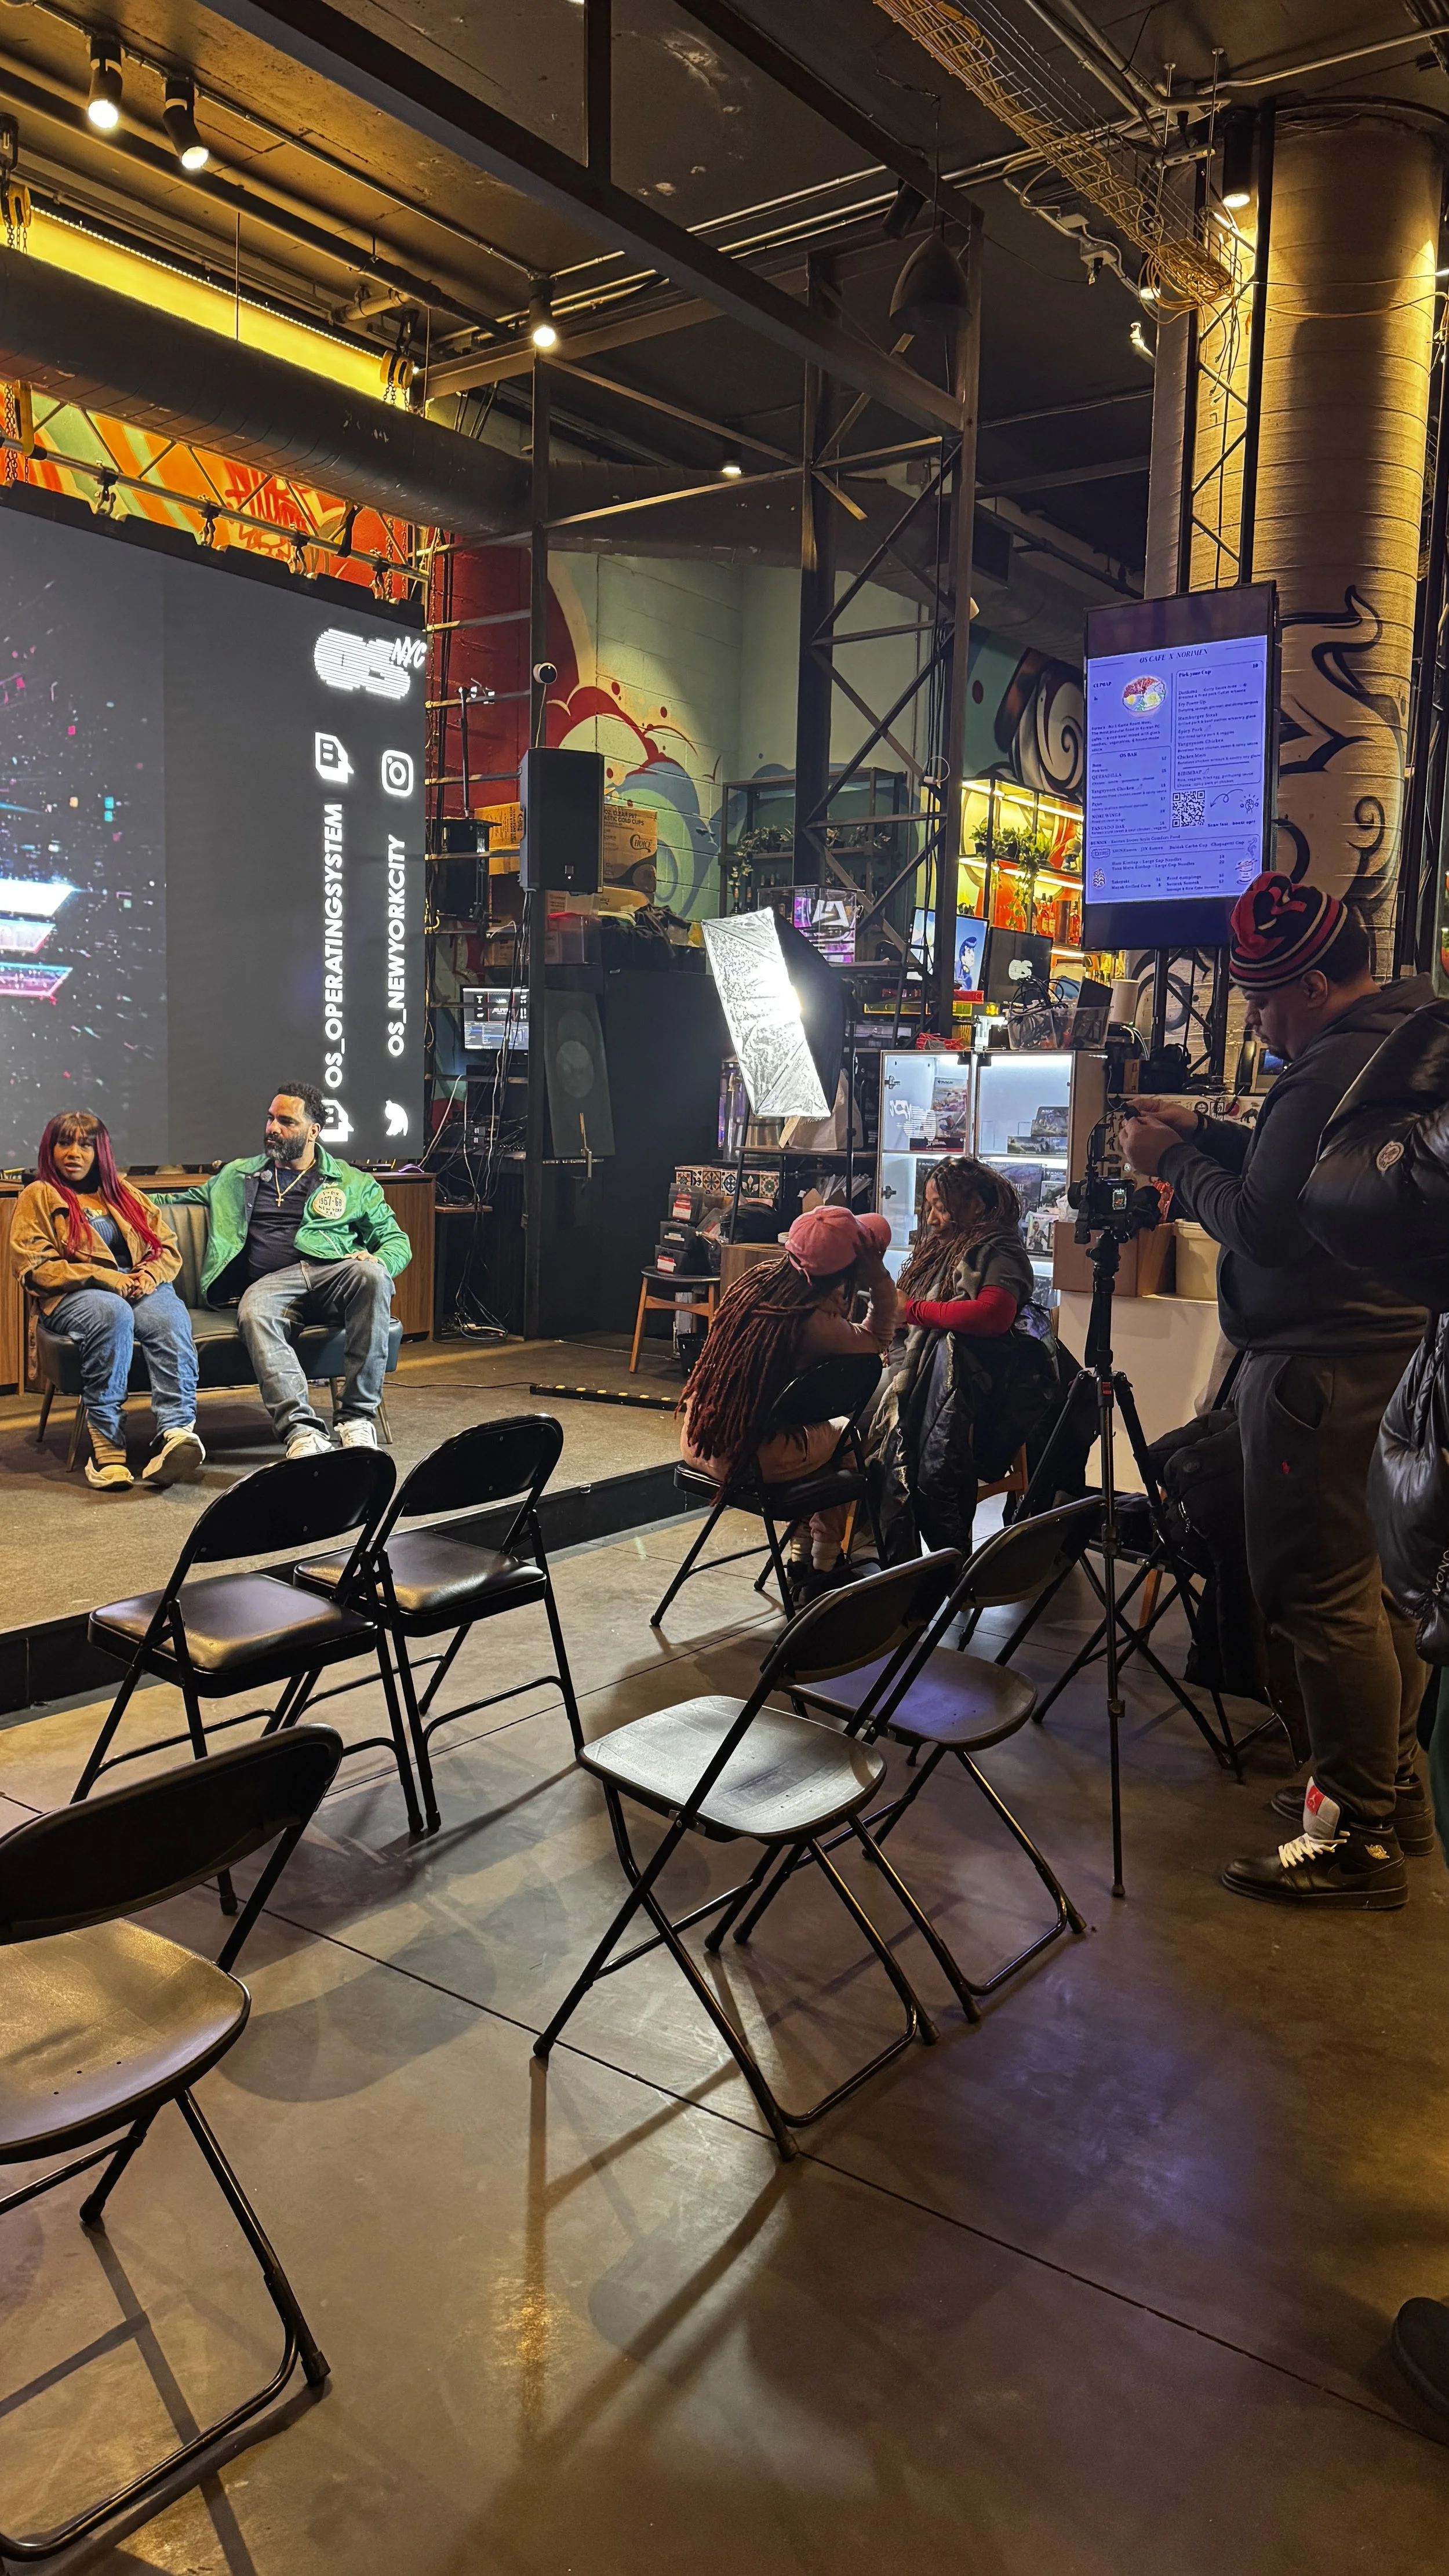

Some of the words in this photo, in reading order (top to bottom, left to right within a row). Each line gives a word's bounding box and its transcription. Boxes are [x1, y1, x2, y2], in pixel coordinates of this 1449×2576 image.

[391, 636, 426, 668] NYC
[324, 803, 345, 1088] OS_OPERATINGSYSTEM
[387, 834, 407, 1057] OS_NEWYORKCITY
[319, 1196, 342, 1206] 1967-68
